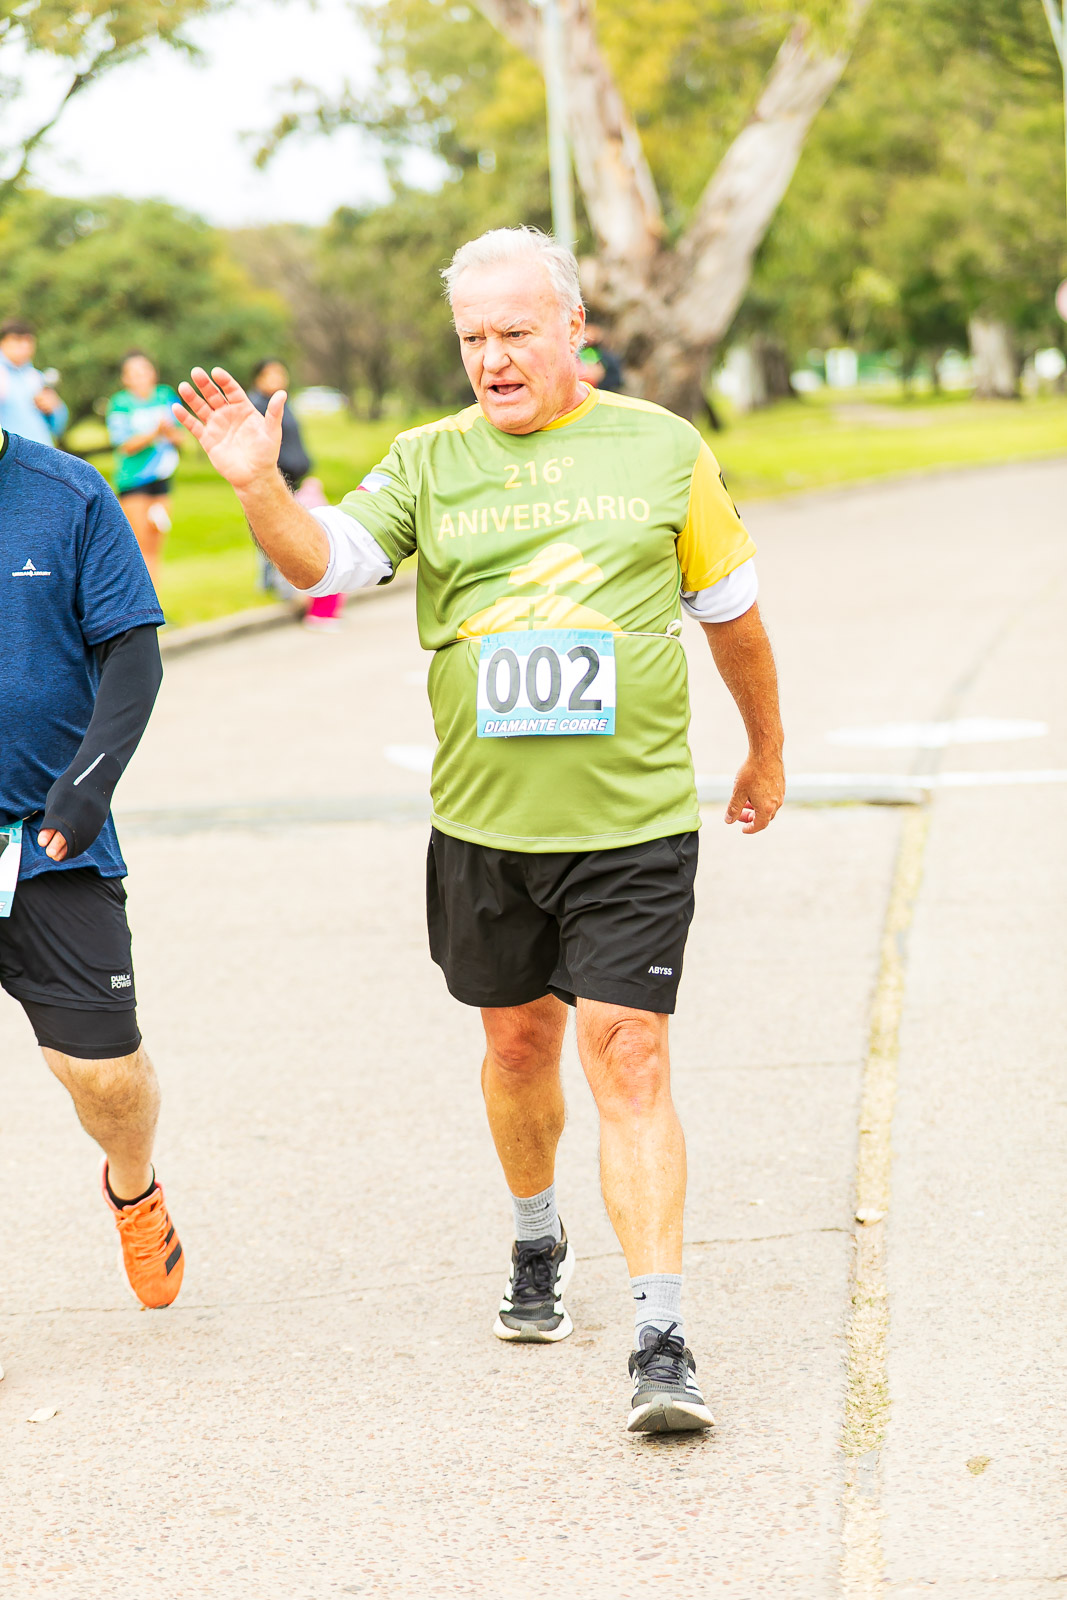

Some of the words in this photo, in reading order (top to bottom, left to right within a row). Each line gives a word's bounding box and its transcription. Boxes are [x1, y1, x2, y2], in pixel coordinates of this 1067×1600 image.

[438, 496, 650, 542] ANIVERSARIO
[486, 646, 602, 714] 002
[483, 719, 556, 734] DIAMANTE
[559, 718, 609, 732] CORRE
[648, 965, 673, 976] ABYSS
